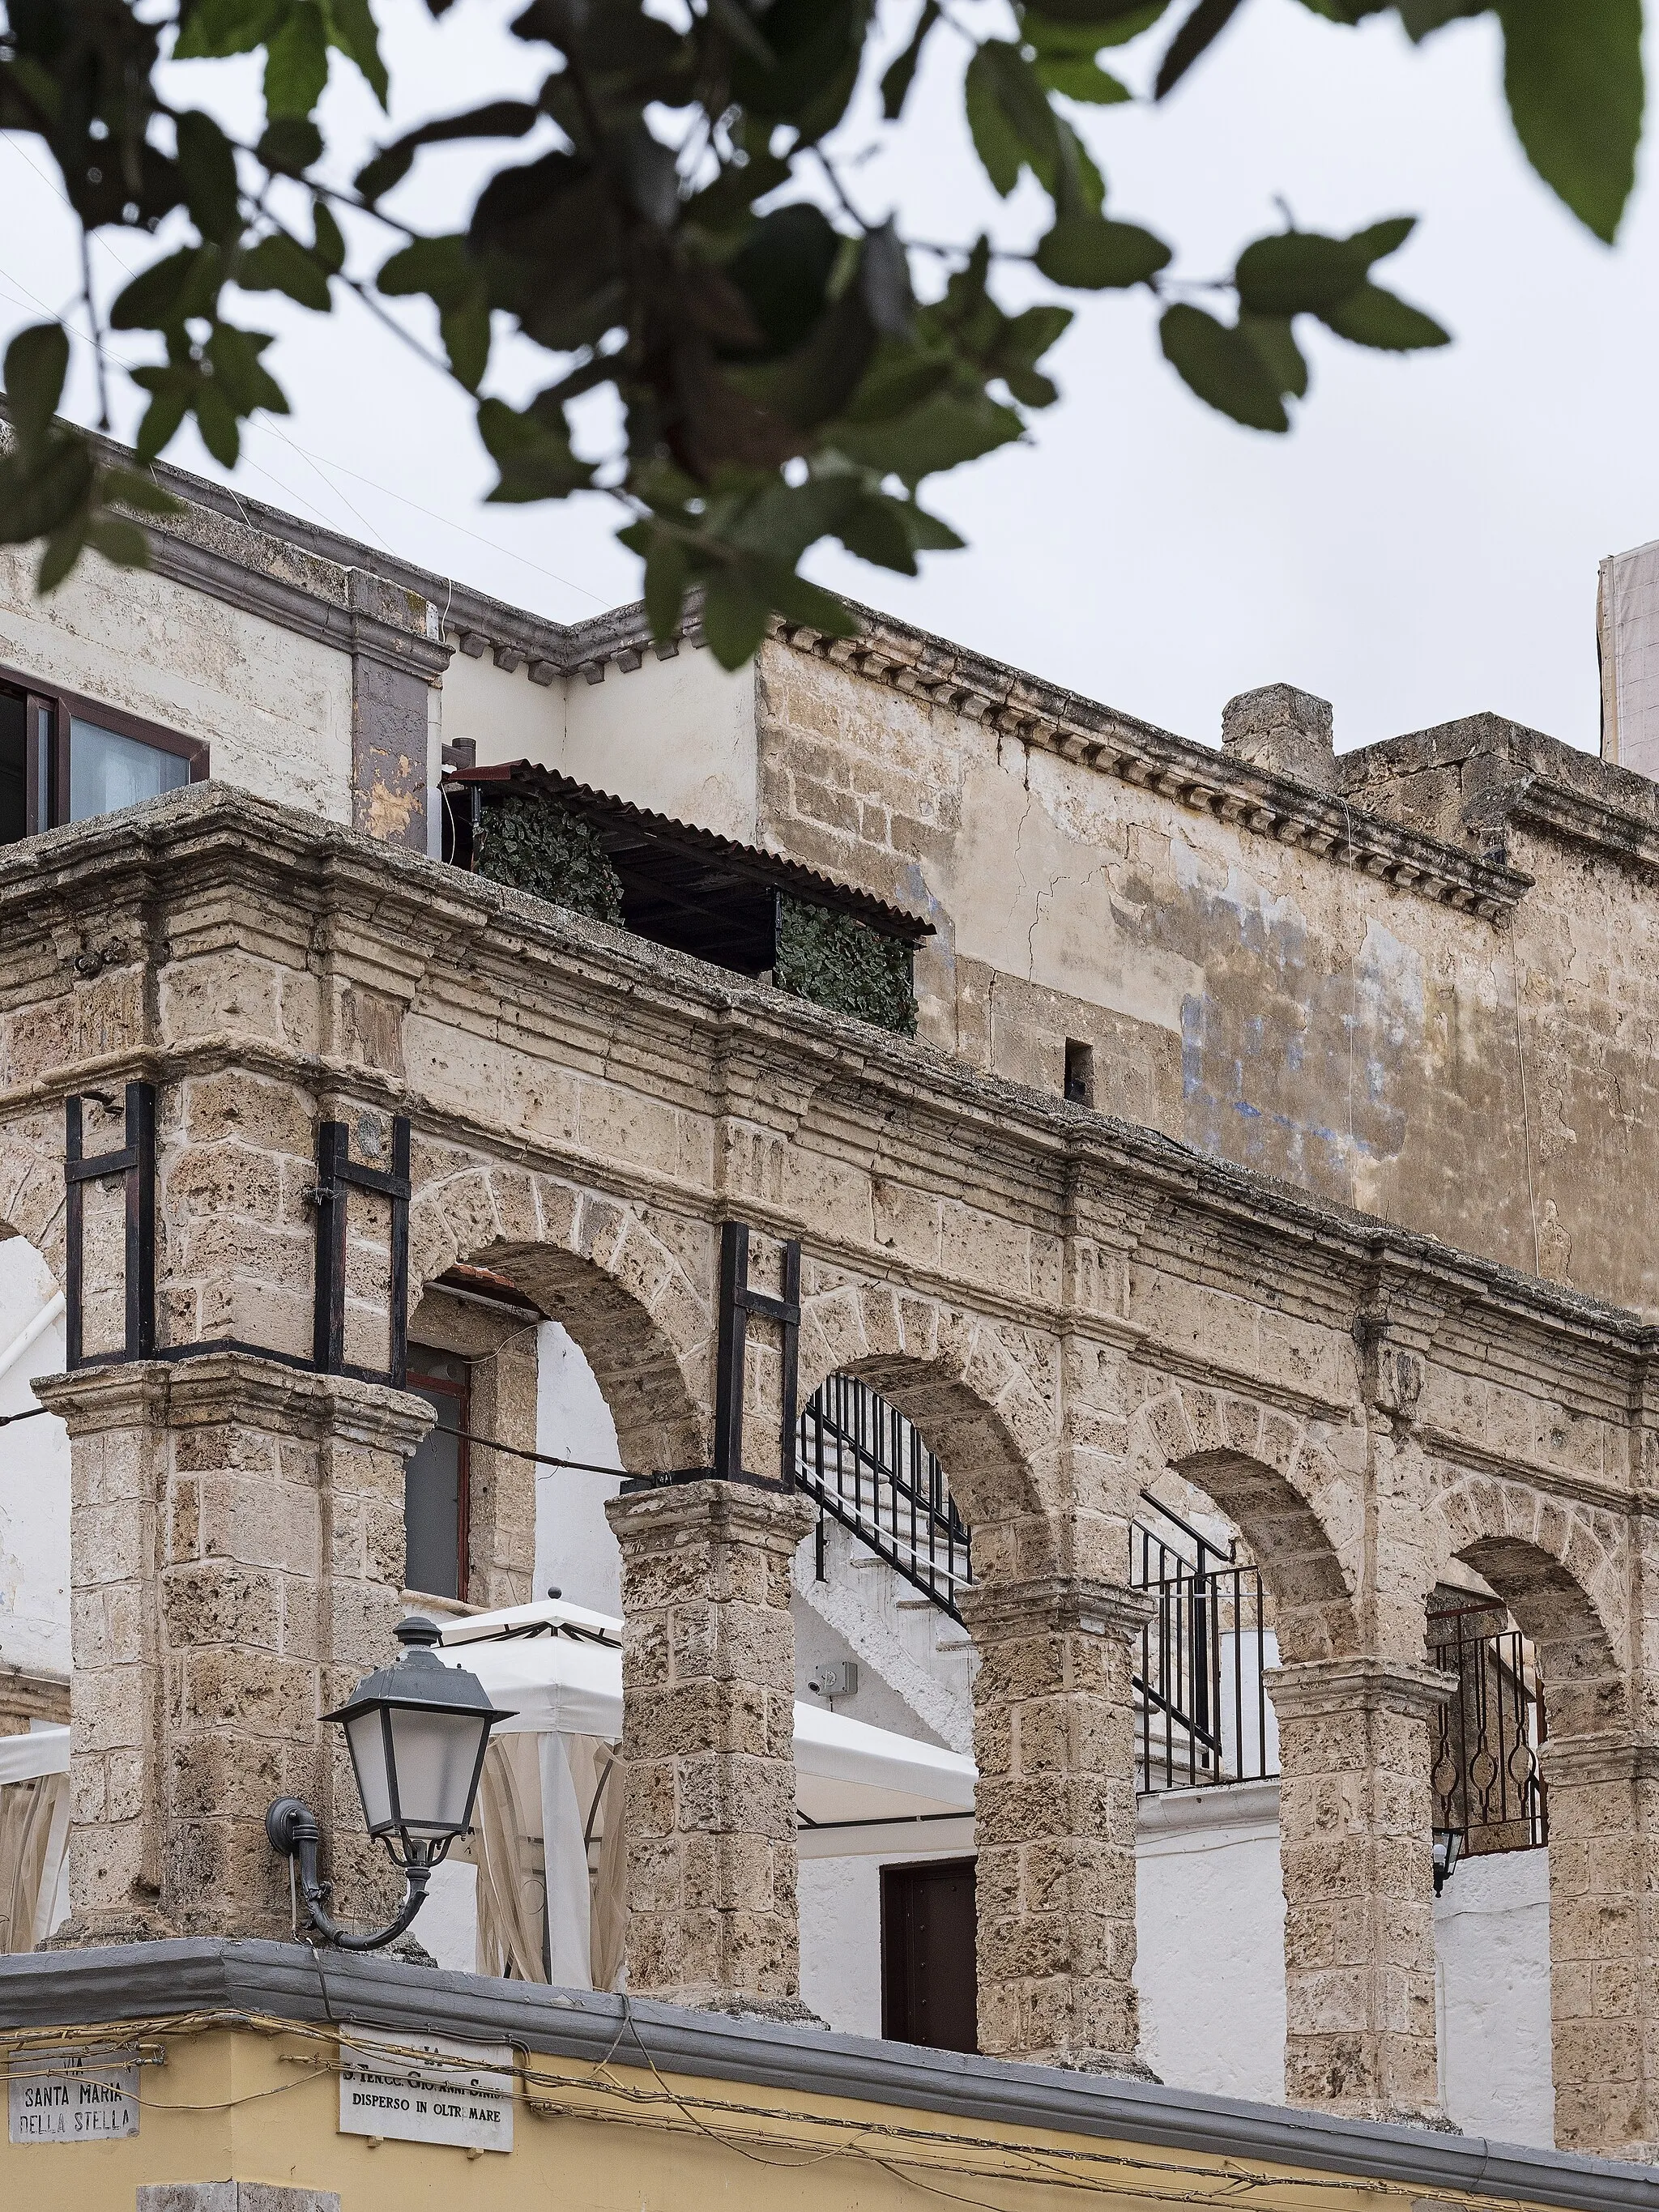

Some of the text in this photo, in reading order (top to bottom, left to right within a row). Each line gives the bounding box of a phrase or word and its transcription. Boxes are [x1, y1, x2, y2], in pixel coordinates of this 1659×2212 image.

[25, 2082, 122, 2107] SANTA MARIA
[352, 2093, 409, 2110] DISPERSO
[416, 2101, 428, 2113] IN
[20, 2109, 130, 2134] DELLA STELLA
